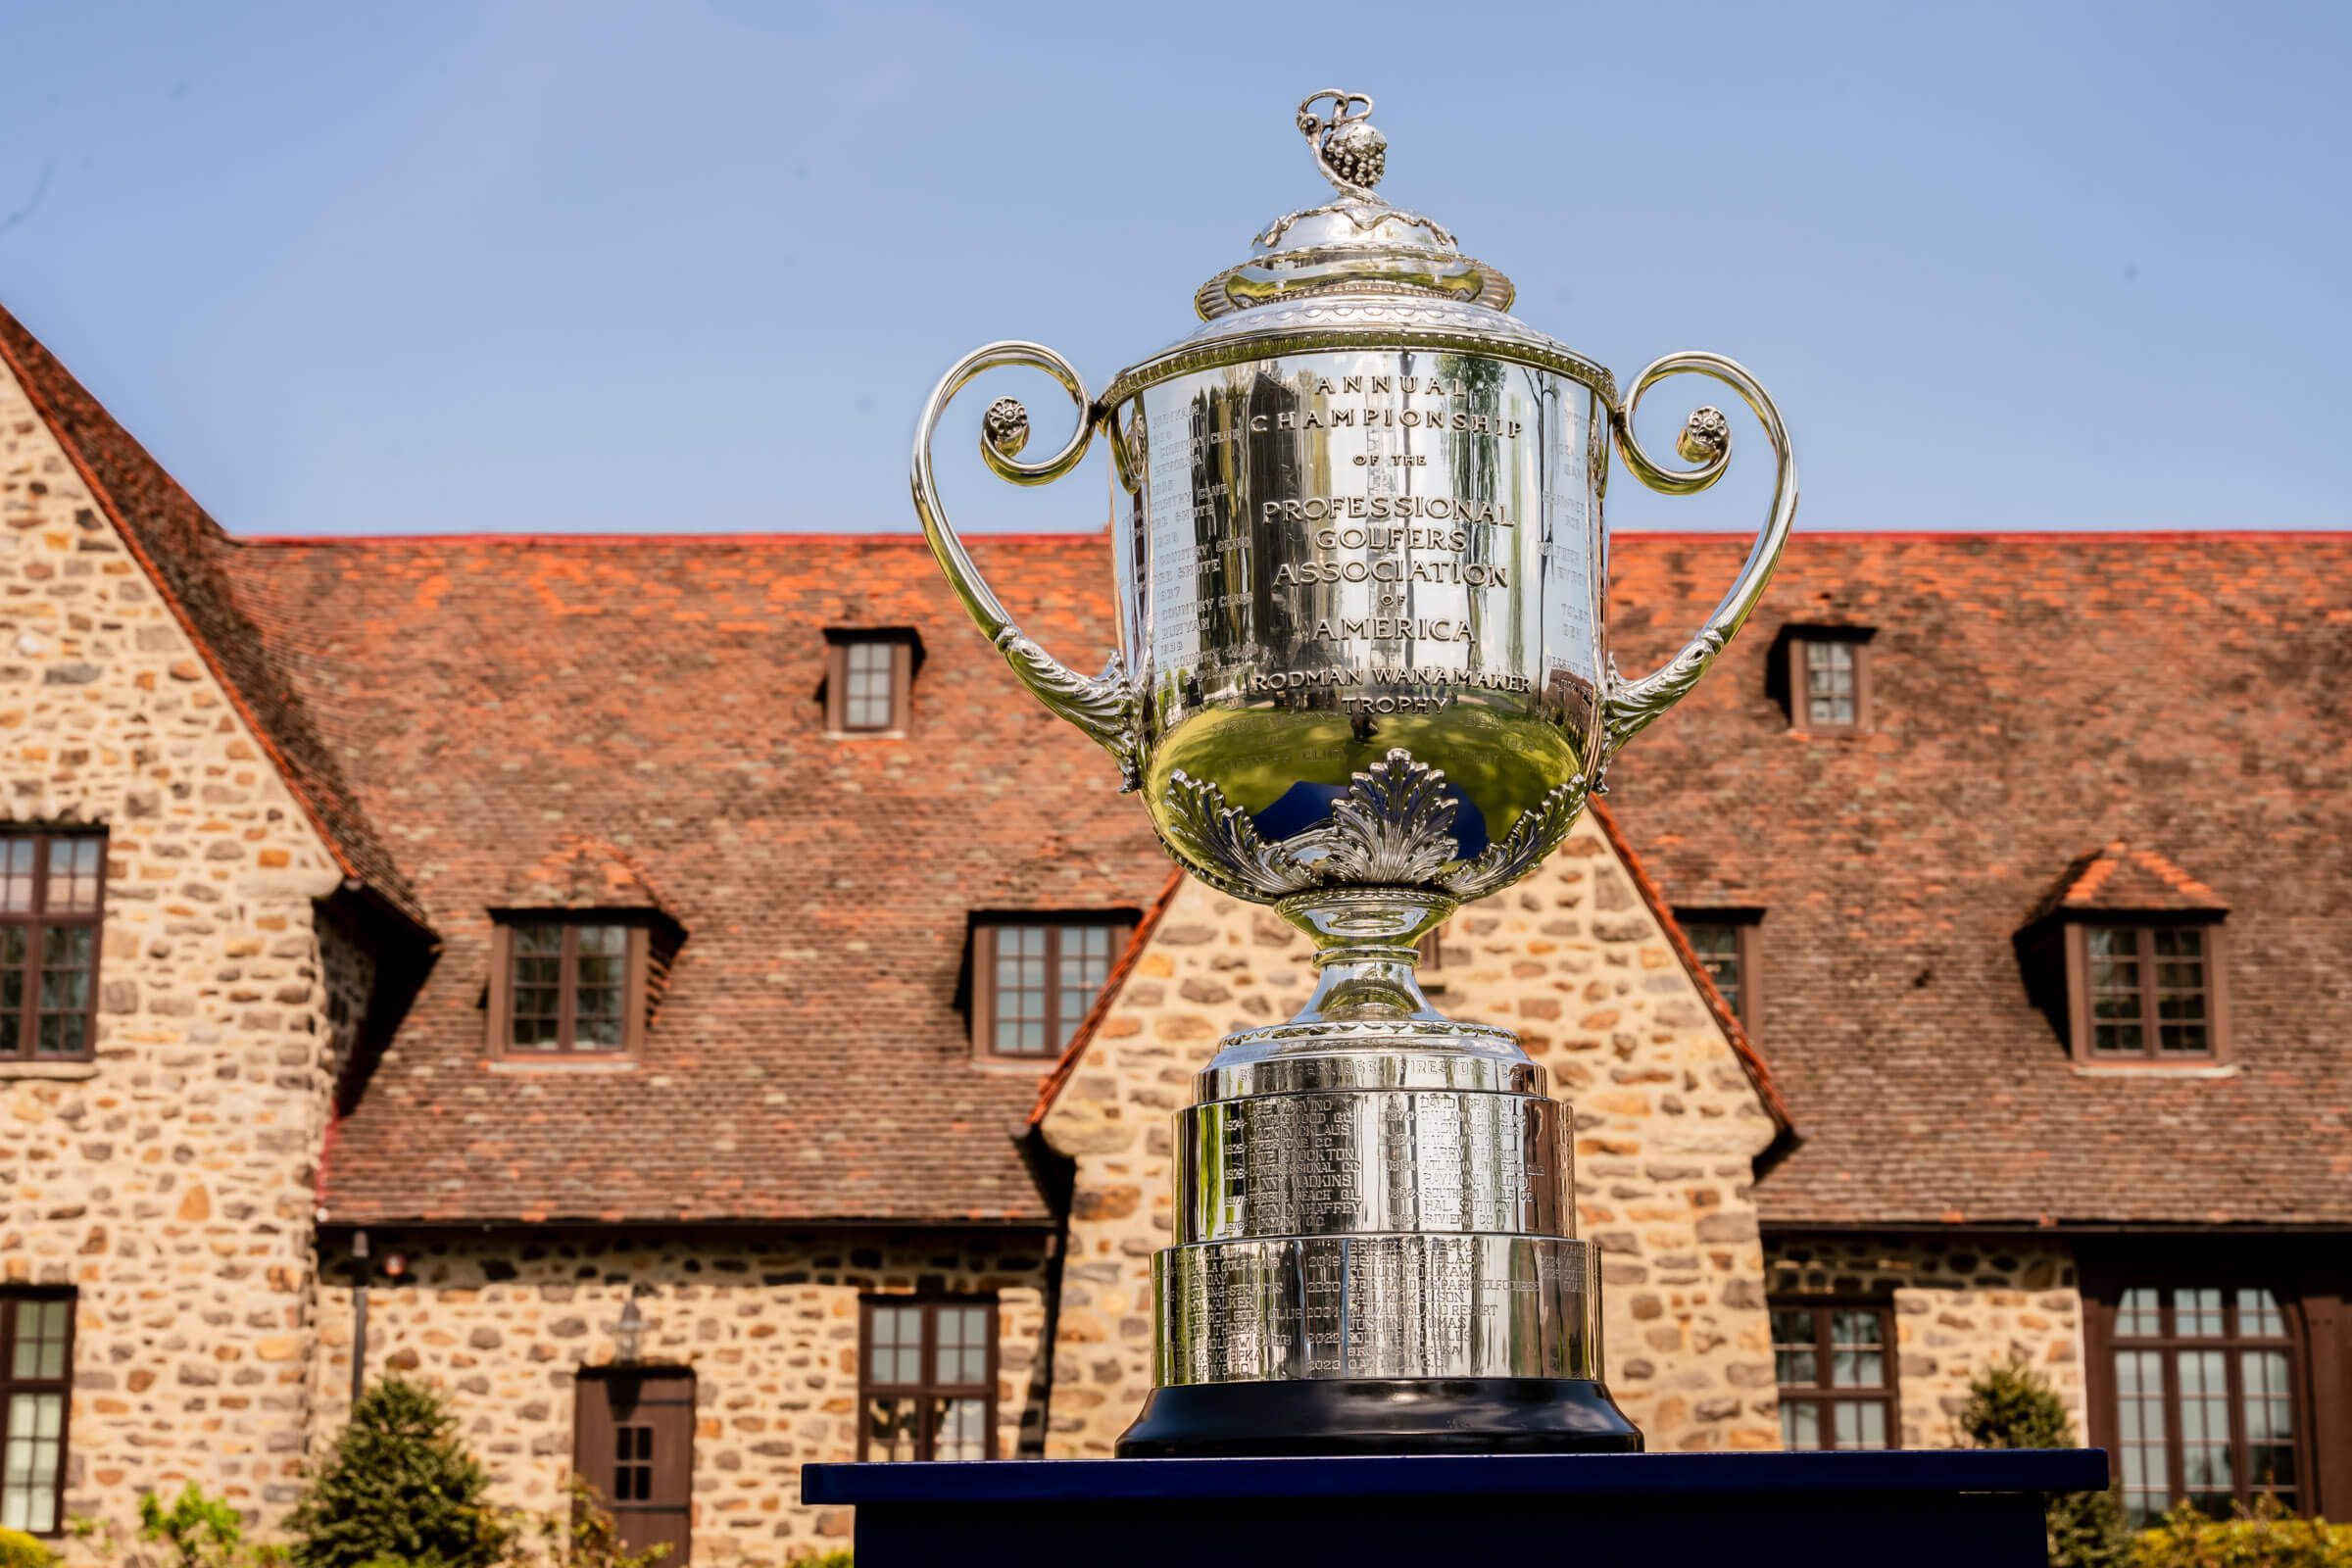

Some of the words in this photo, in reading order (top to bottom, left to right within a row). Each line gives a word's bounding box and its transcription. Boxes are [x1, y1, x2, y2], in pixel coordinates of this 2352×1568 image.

[1315, 375, 1467, 398] ANNUAL
[1250, 408, 1522, 438] CHAMPIONSHIP
[1352, 454, 1379, 466] OF
[1391, 454, 1427, 466] THE
[1262, 496, 1515, 526] PROFESSIONAL
[1316, 527, 1467, 552] GOLFERS
[1273, 560, 1508, 588] ASSOCIATION
[1380, 593, 1406, 607] OF
[1311, 617, 1476, 643] AMERICA
[1253, 668, 1363, 692] RODMAN
[1372, 666, 1532, 694] WANAMAKER
[1342, 697, 1451, 715] TROPHY
[1282, 1148, 1356, 1162] STOCKTON
[1424, 1200, 1453, 1212] HAL
